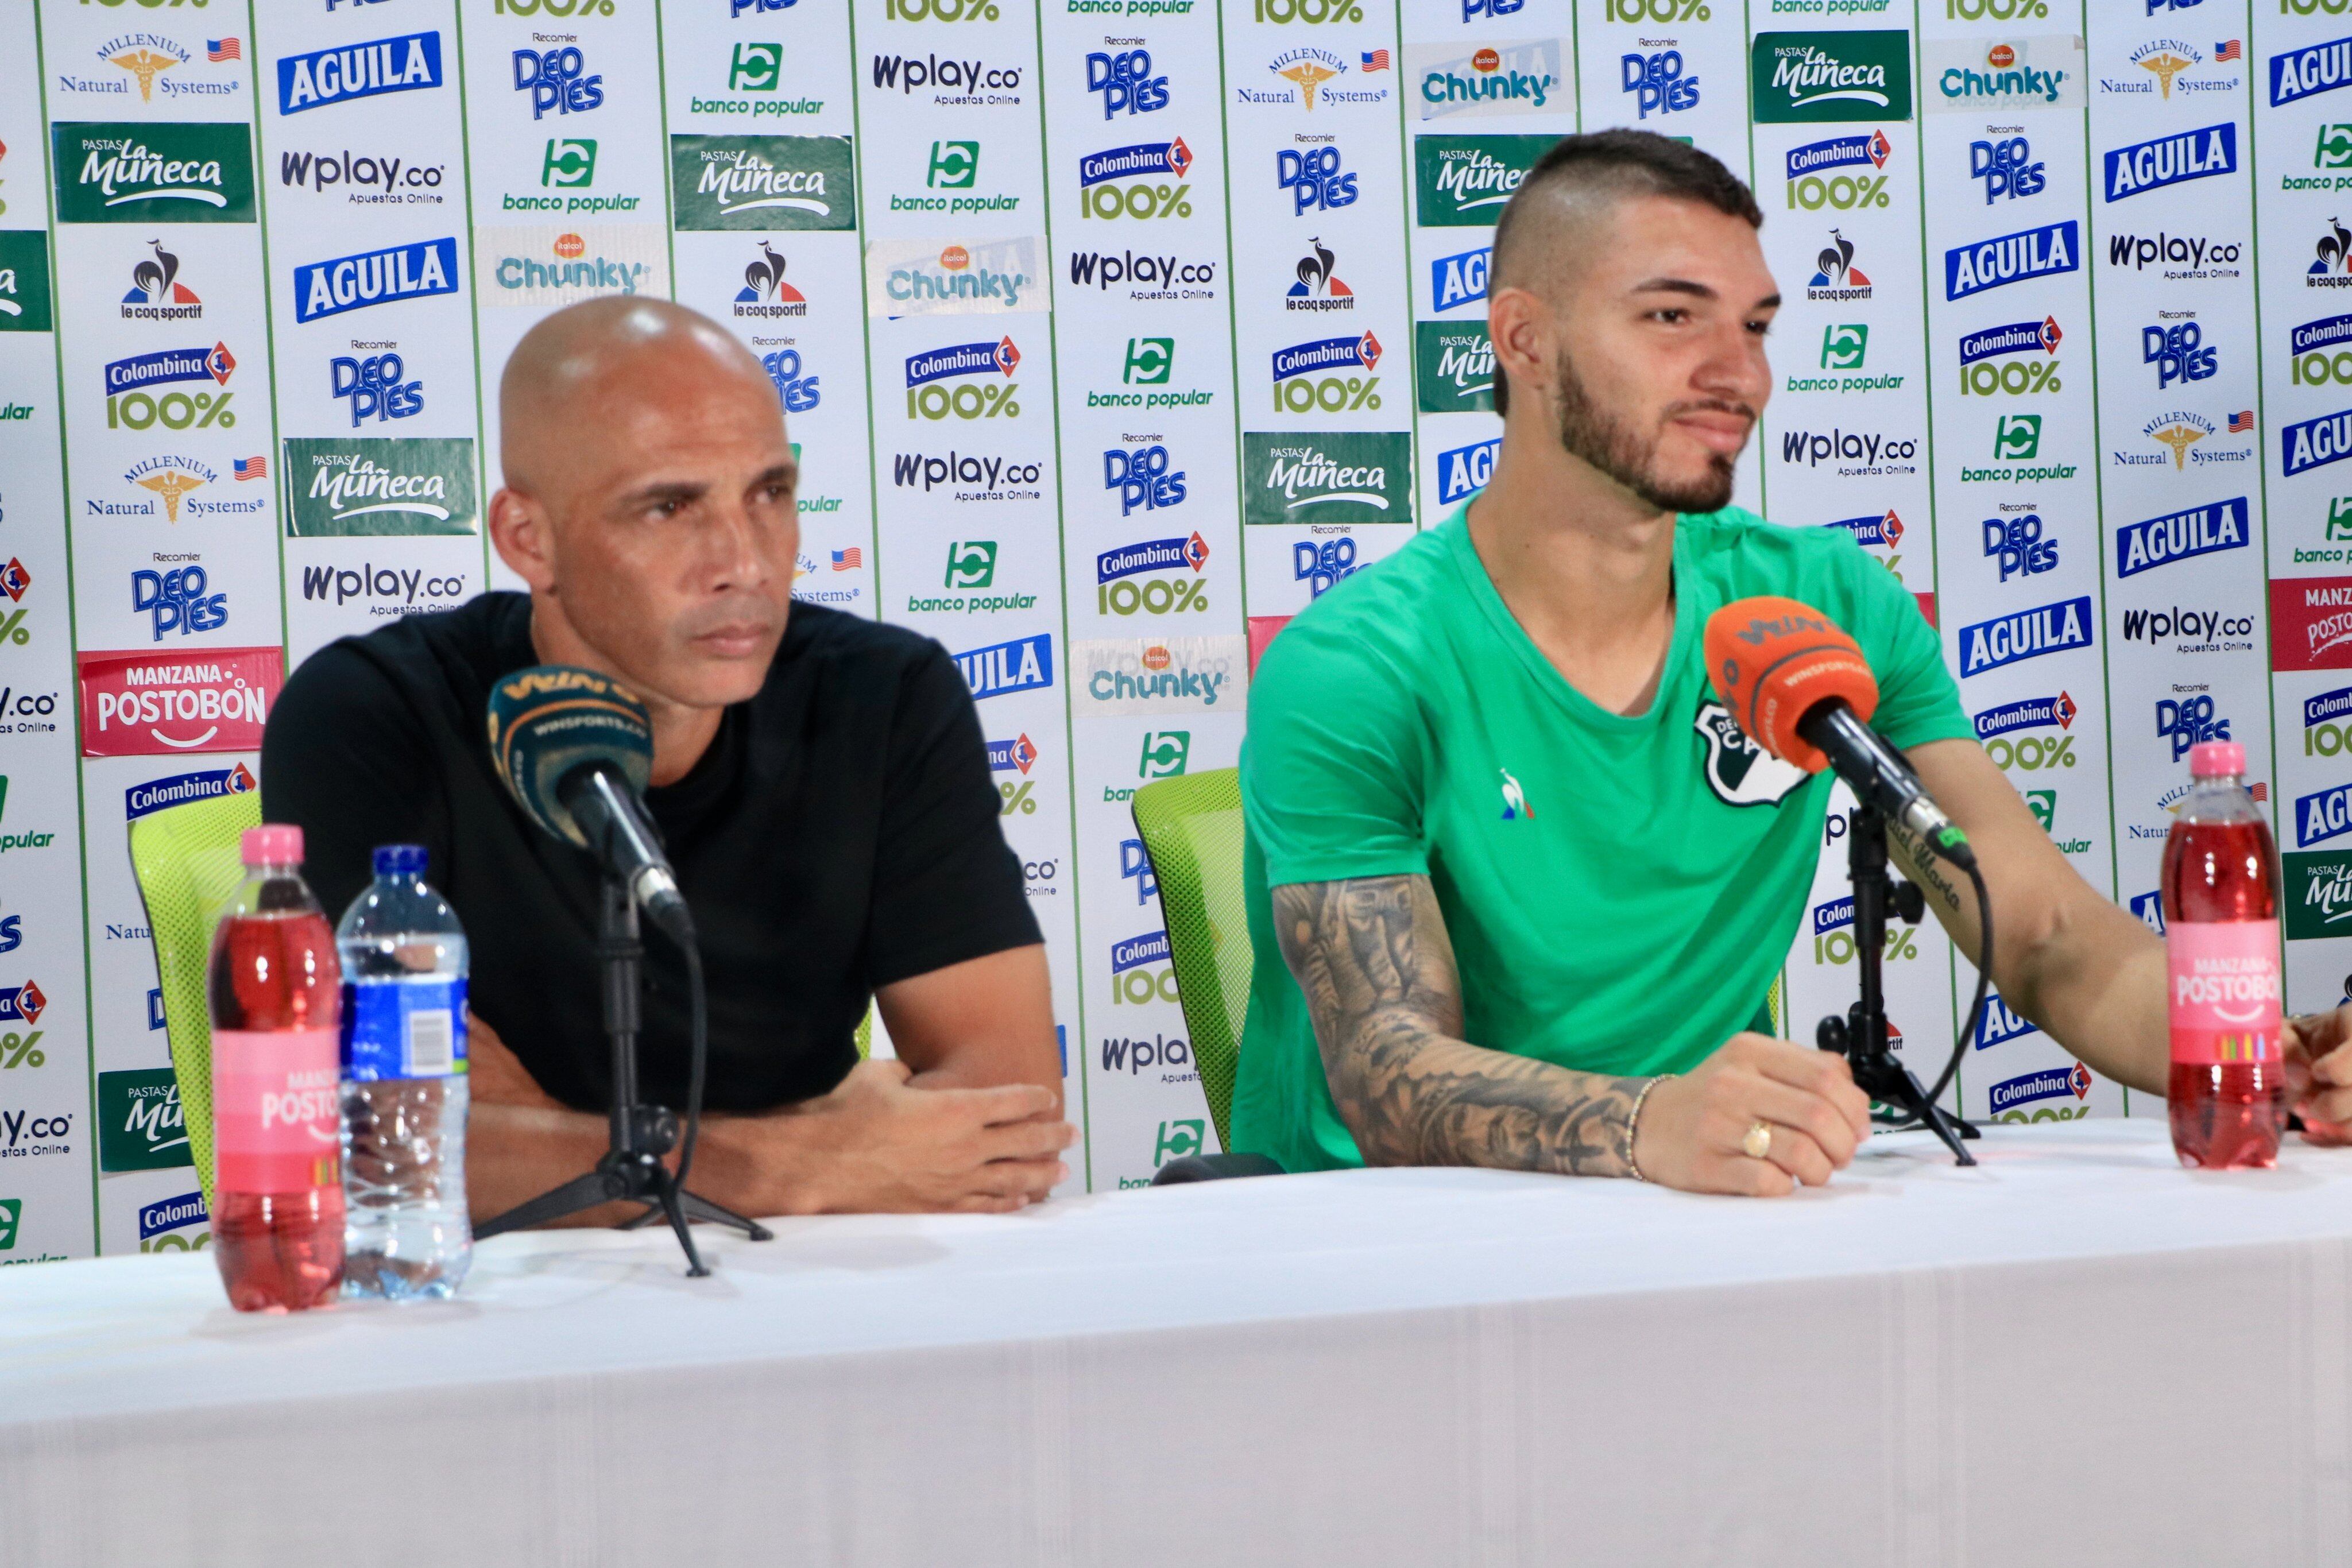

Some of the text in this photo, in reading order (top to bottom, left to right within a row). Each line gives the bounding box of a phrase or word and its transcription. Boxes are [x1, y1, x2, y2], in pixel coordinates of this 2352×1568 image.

[96, 33, 192, 65] MILLENIUM
[532, 32, 578, 42] Recamier
[1104, 36, 1146, 45] Recamier
[1268, 48, 1348, 74] MILLENIUM
[1475, 56, 1497, 64] italcol
[1775, 46, 1826, 65] PASTAS La
[1991, 52, 2012, 60] italcol
[2129, 40, 2203, 65] MILLENIUM
[288, 39, 432, 109] AGUILA
[512, 47, 583, 91] DEO
[873, 53, 1019, 95] Wplay.co
[1086, 49, 1151, 92] DEO
[1771, 59, 1886, 98] Muñeca
[2277, 42, 2352, 101] AGUI
[59, 76, 128, 93] Natural
[1237, 88, 1295, 103] Natural
[2100, 79, 2153, 93] Natural
[690, 96, 824, 118] banco popular
[934, 95, 1020, 106] Apuestas Online
[1294, 133, 1336, 142] Recamier
[1986, 125, 2025, 134] Recamier
[82, 138, 147, 160] PASTAS La
[701, 150, 759, 171] PASTAS La
[1439, 149, 1492, 169] PASTAS La
[1790, 142, 1864, 169] Colombina
[1970, 137, 2030, 179] DEO
[79, 153, 222, 196] Muñeca
[281, 150, 442, 193] Wplay.co
[1085, 149, 1164, 178] Colombina
[1276, 146, 1341, 189] DEO
[2111, 130, 2229, 196] AGUILA
[697, 161, 827, 206] Muñeca
[1787, 175, 1890, 211] 100%
[349, 193, 443, 205] Apuestas Online
[502, 193, 640, 215] banco popular
[890, 193, 1020, 215] banco popular
[1081, 184, 1192, 220] 100%
[1952, 228, 2071, 295] AGUILA
[2110, 232, 2239, 271] Wplay.co
[304, 246, 450, 316] AGUILA
[1071, 250, 1213, 291] Wplay.co
[2163, 269, 2239, 281] Apuestas Online
[1130, 289, 1214, 301] Apuestas Online
[1286, 296, 1354, 312] le coq sportif
[1808, 287, 1872, 302] le coq sportif
[121, 304, 202, 322] le coq sportif
[733, 303, 807, 319] le coq sportif
[2159, 309, 2196, 319] Recamier
[351, 339, 397, 349] Recamier
[752, 336, 795, 346] Recamier
[1440, 336, 1472, 346] PASTAS
[1964, 326, 2036, 355] Colombina
[2142, 322, 2201, 363] DEO
[110, 353, 202, 384] Colombina
[910, 349, 991, 378] Colombina
[1277, 342, 1354, 371] Colombina
[330, 353, 404, 398] DEO
[1787, 373, 1904, 394] banco popular
[1960, 361, 2061, 396] 100%
[907, 384, 1020, 420] 100%
[1087, 389, 1213, 410] banco popular
[1273, 377, 1382, 413] 100%
[106, 392, 235, 431] 100%
[2142, 411, 2216, 437] MILLENIUM
[1122, 432, 1163, 442] Recamier
[1784, 428, 1915, 468] Wplay.co
[123, 456, 219, 484] MILLENIUM
[312, 454, 374, 475] PASTAS La
[1104, 446, 1169, 489] DEO
[1270, 447, 1324, 467] PASTAS La
[2114, 451, 2167, 465] Natural
[894, 450, 1039, 492] Wplay.co
[1267, 459, 1386, 499] Muñeca
[1838, 465, 1916, 477] Apuestas Online
[1961, 463, 2077, 484] banco popular
[309, 467, 445, 511] Muñeca
[954, 490, 1040, 503] Apuestas Online
[86, 500, 155, 515] Natural
[1999, 502, 2037, 512] Recamier
[1311, 525, 1351, 534] Recamier
[1983, 515, 2042, 557] DEO
[2125, 506, 2241, 572] AGUILA
[153, 552, 200, 562] Recamier
[1102, 544, 1180, 572] Colombina
[1293, 537, 1357, 580] DEO
[132, 566, 208, 612] DEO
[303, 563, 462, 606] Wplay.co
[1098, 578, 1208, 615] 100%
[2305, 589, 2352, 606] MANZ
[370, 605, 423, 617] Apuestas
[908, 592, 1037, 614] banco popular
[1967, 605, 2084, 672] AGUILA
[2123, 606, 2252, 645] Wplay.co
[2176, 641, 2253, 654] Apuestas Online
[126, 664, 223, 686] MANZANA
[2172, 683, 2210, 692] Recamier
[1978, 703, 2050, 733] Colombina
[2156, 695, 2214, 737] DEO
[130, 775, 223, 808] Colombina
[2307, 865, 2338, 876] PASTAS
[2177, 975, 2278, 1006] POSTOBO
[128, 1085, 167, 1097] PASTAS
[1993, 1077, 2065, 1106] Colombina
